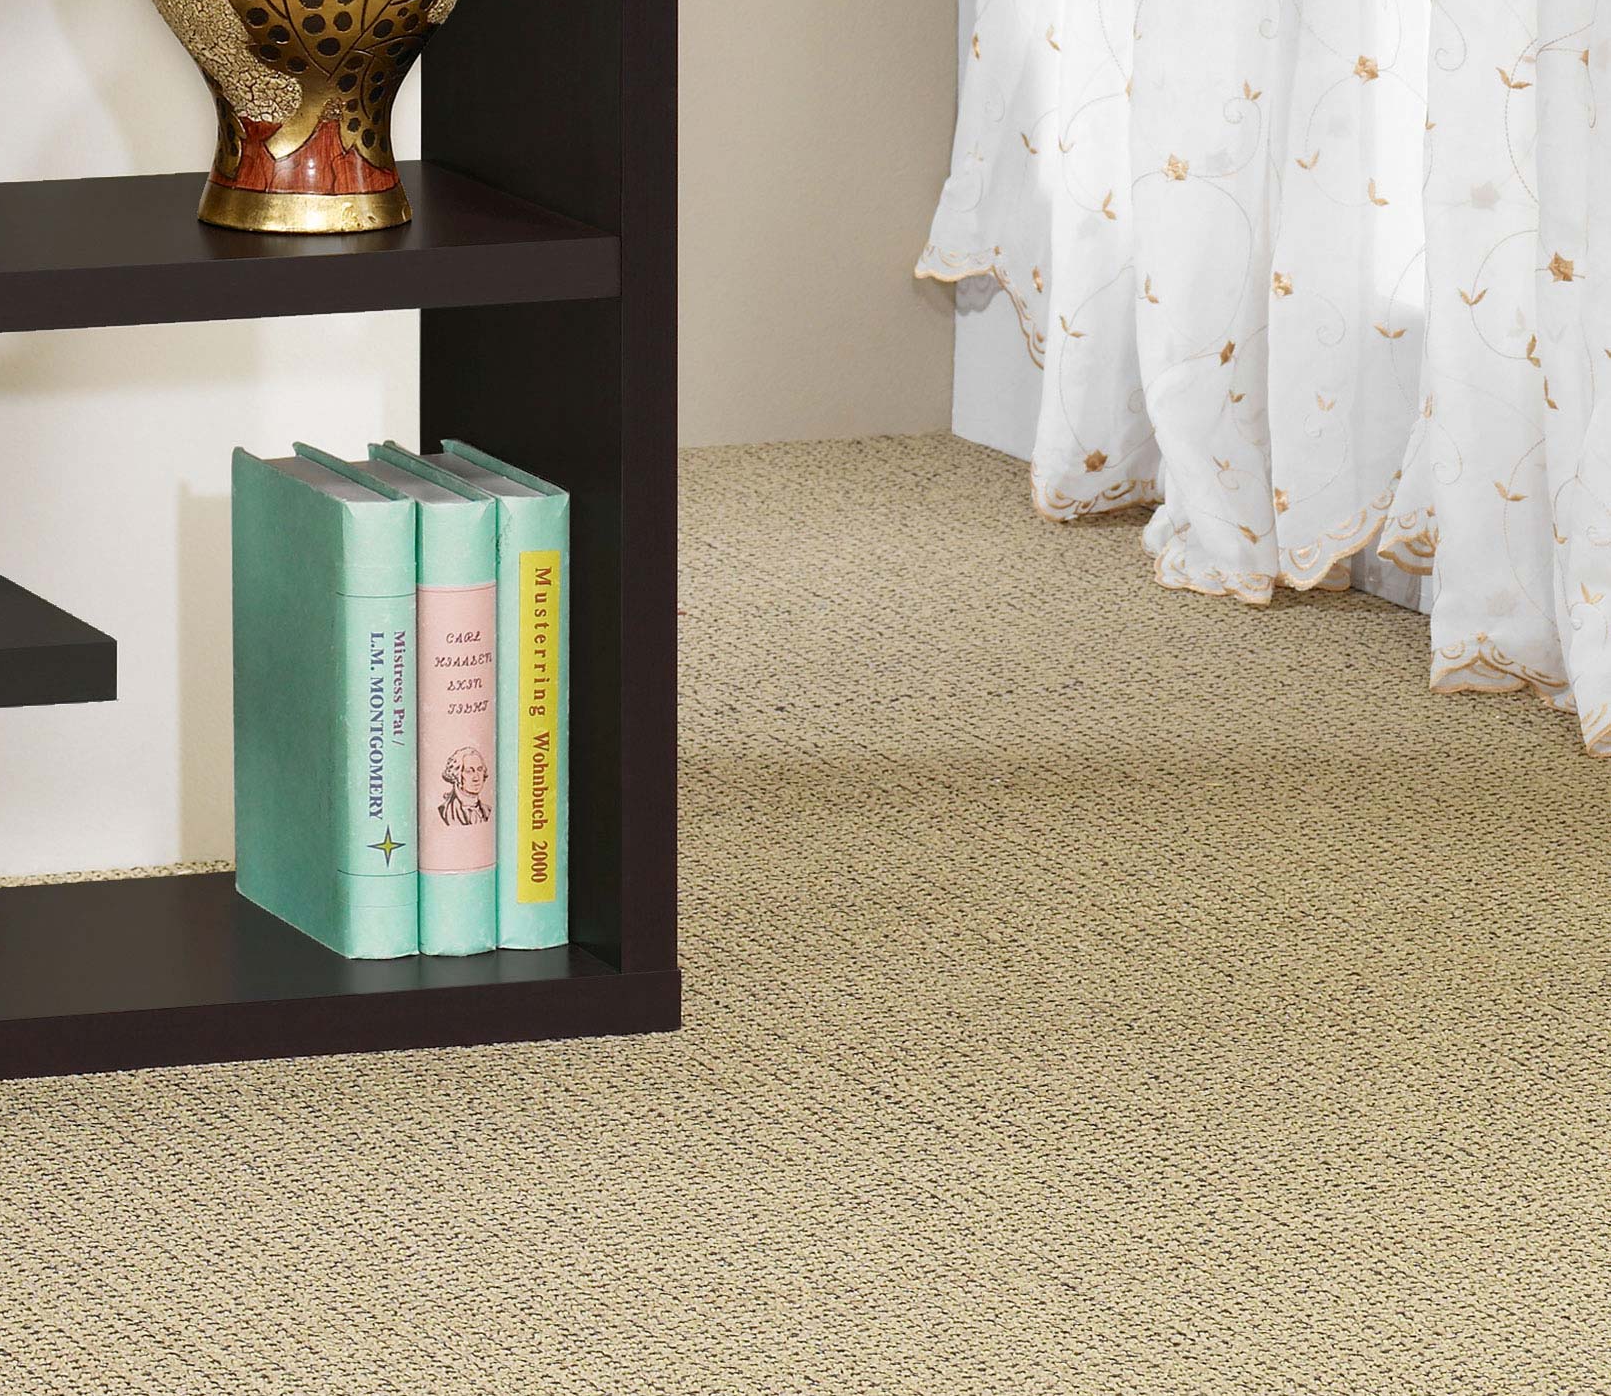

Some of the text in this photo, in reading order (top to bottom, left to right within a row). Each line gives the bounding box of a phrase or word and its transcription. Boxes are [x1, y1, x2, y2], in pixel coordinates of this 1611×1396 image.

[393, 631, 406, 703] Mistress
[446, 631, 481, 644] CARL
[369, 676, 384, 820] MONTGOMERY
[393, 708, 406, 736] Pat
[529, 566, 552, 883] Musterring Wohnbuch 2000
